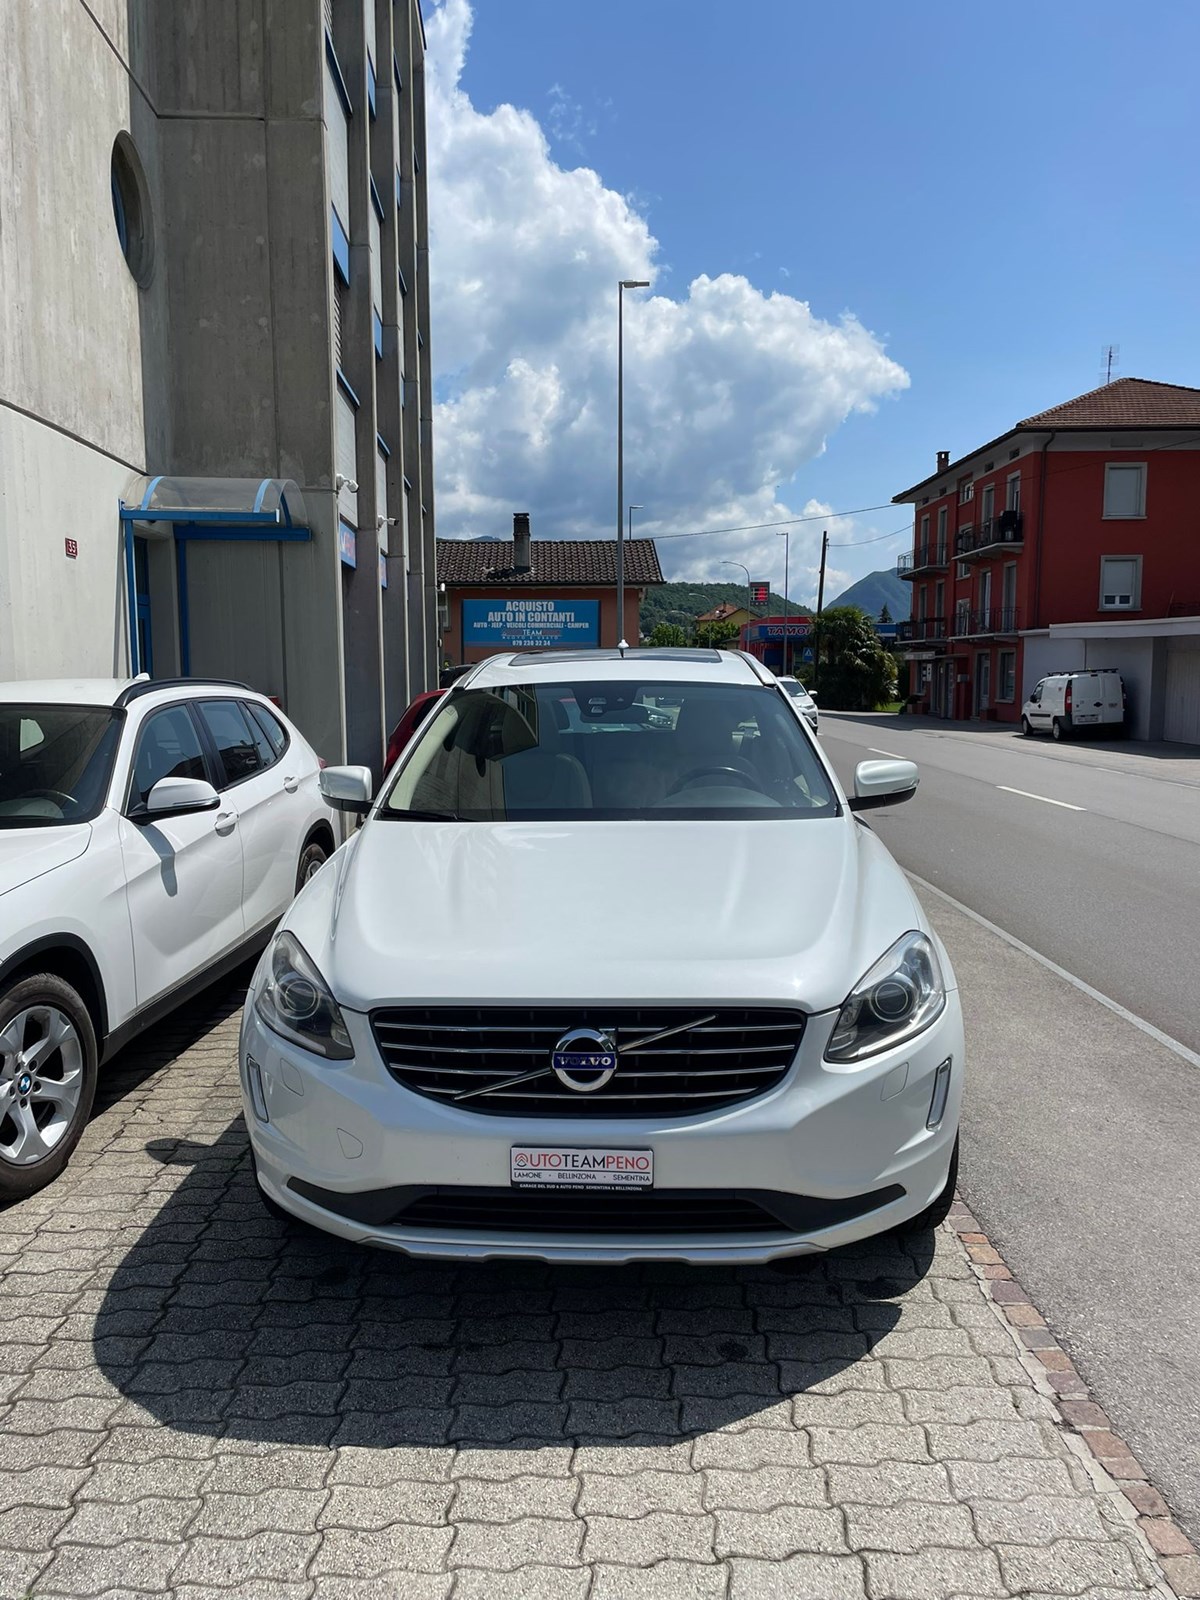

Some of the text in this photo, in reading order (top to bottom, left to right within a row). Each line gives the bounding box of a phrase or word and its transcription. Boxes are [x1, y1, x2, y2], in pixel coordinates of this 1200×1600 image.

[505, 601, 555, 612] ACQUISTO
[487, 612, 575, 622] AUTO IN CONTANTI
[767, 626, 811, 636] TAMOI
[556, 1056, 612, 1066] VOLVO
[514, 1171, 650, 1182] LAMONE BELLINZONA SEMENTINA
